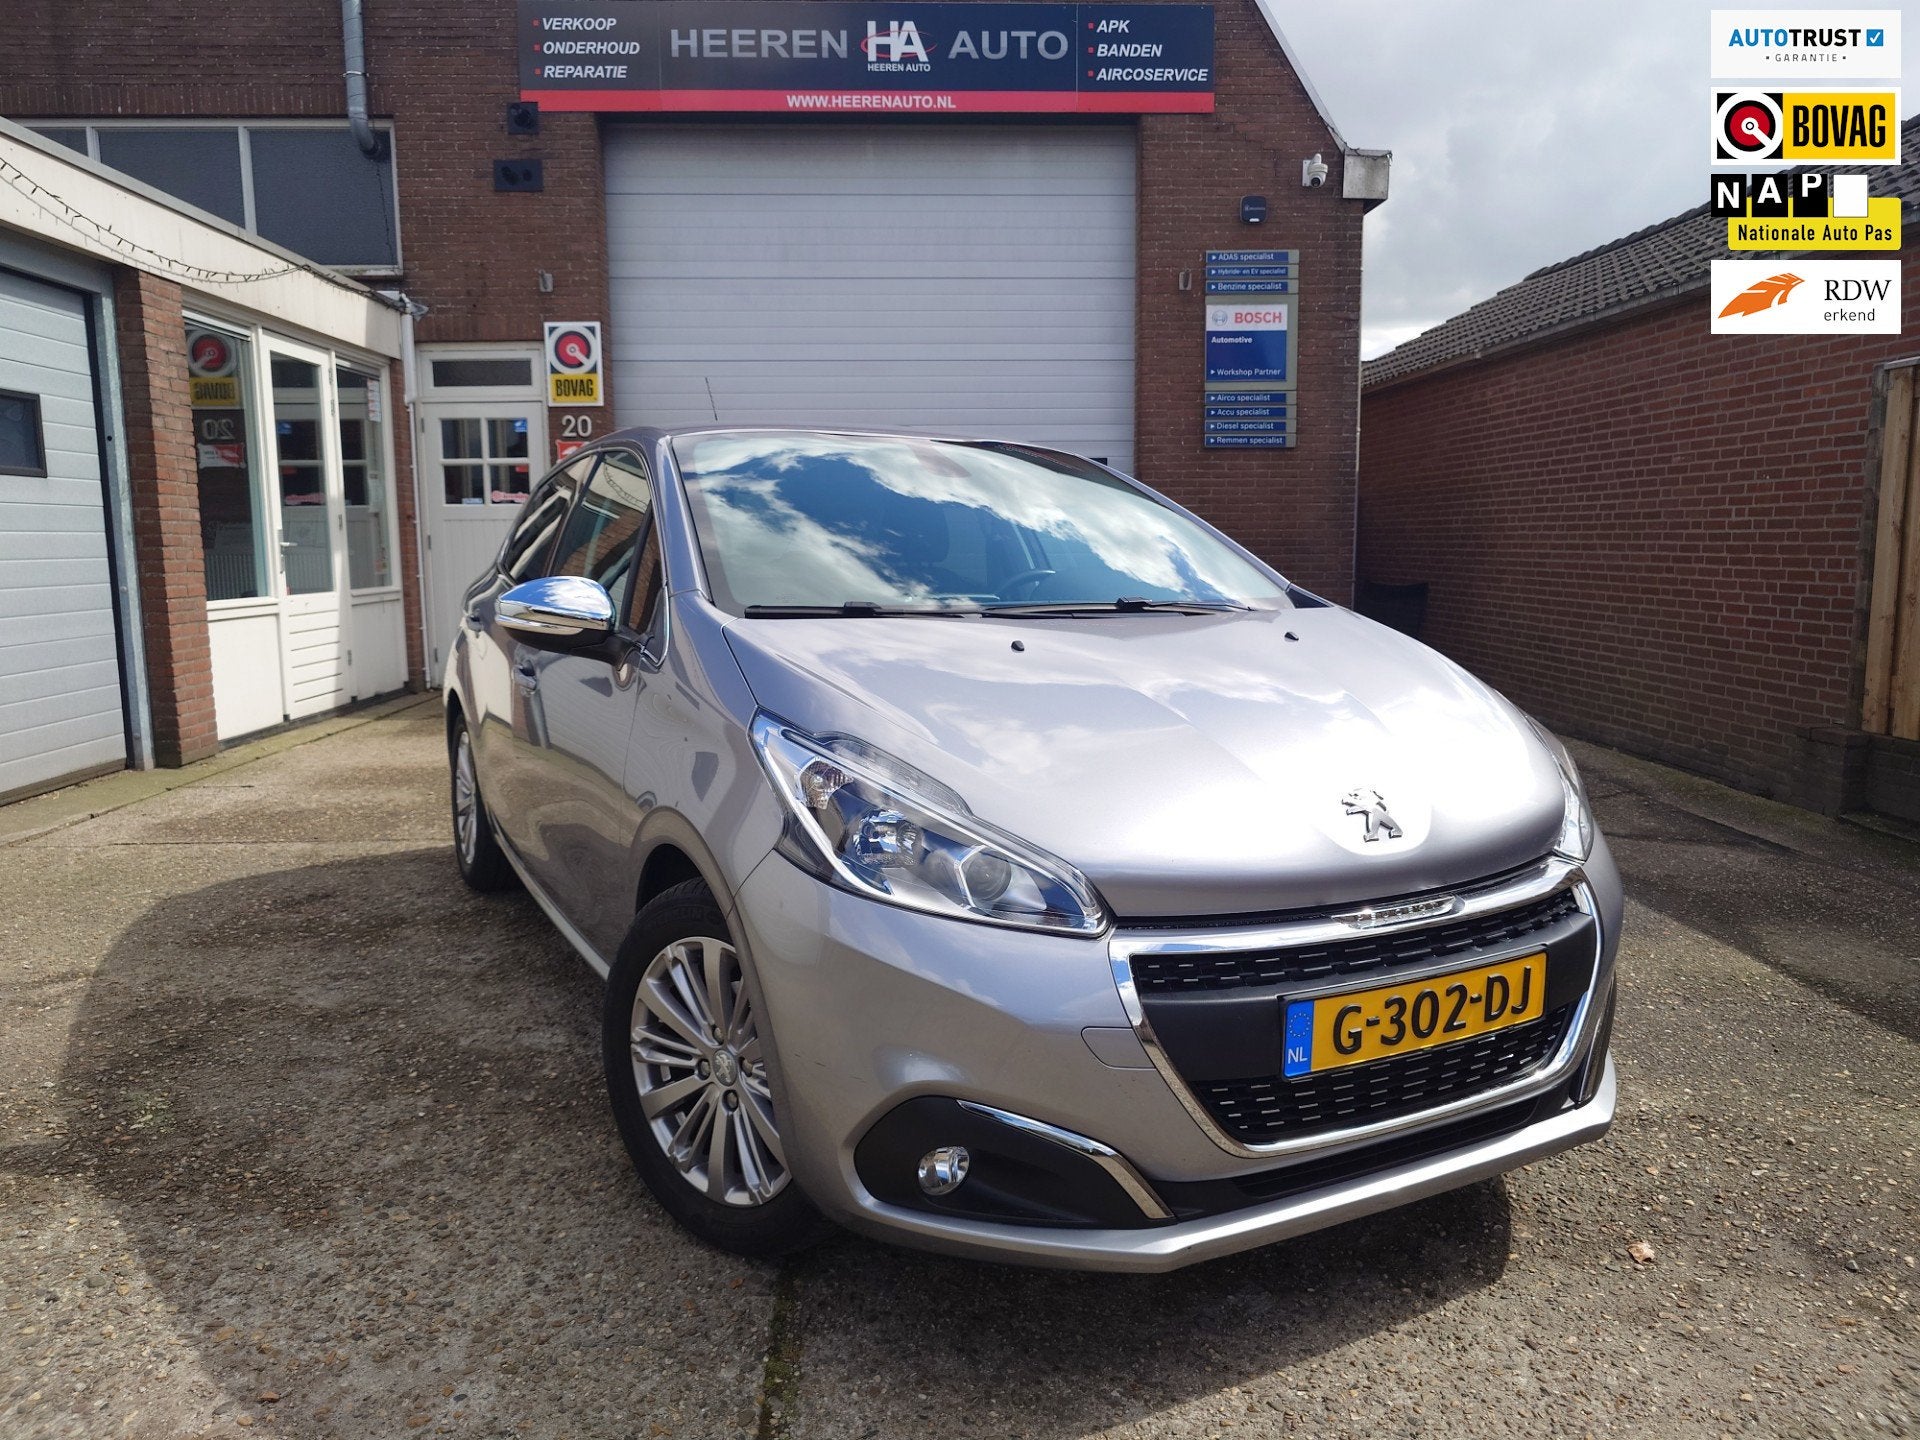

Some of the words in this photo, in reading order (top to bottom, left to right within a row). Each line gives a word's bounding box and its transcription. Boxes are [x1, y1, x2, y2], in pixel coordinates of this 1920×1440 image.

[542, 17, 617, 31] VERKOOP
[1096, 19, 1131, 34] APK
[543, 41, 641, 55] ONDERHOUD
[670, 28, 848, 59] HEEREN
[867, 20, 929, 62] HA
[948, 30, 1069, 60] AUTO
[1096, 44, 1162, 58] BANDEN
[543, 65, 628, 79] REPARATIE
[867, 63, 904, 72] HEEREN
[905, 63, 931, 72] AUTO
[1096, 68, 1209, 82] AIRCOSERVICE
[786, 94, 957, 109] WWW.HEERENAUTO.NL
[1240, 252, 1274, 261] specialist
[1248, 282, 1282, 291] specialist
[1234, 312, 1282, 324] BOSCH
[1211, 336, 1253, 344] Automotive
[1216, 368, 1253, 376] Workshop
[1254, 368, 1281, 376] Partner
[555, 378, 593, 397] BOVAG
[1237, 394, 1271, 402] specialist
[1236, 408, 1270, 417] specialist
[561, 414, 592, 438] 20
[1240, 422, 1274, 430] specialist
[1217, 436, 1248, 444] Remmen
[1249, 437, 1283, 445] specialist
[1332, 965, 1532, 1055] G-302-DJ
[1287, 1047, 1308, 1065] NL
